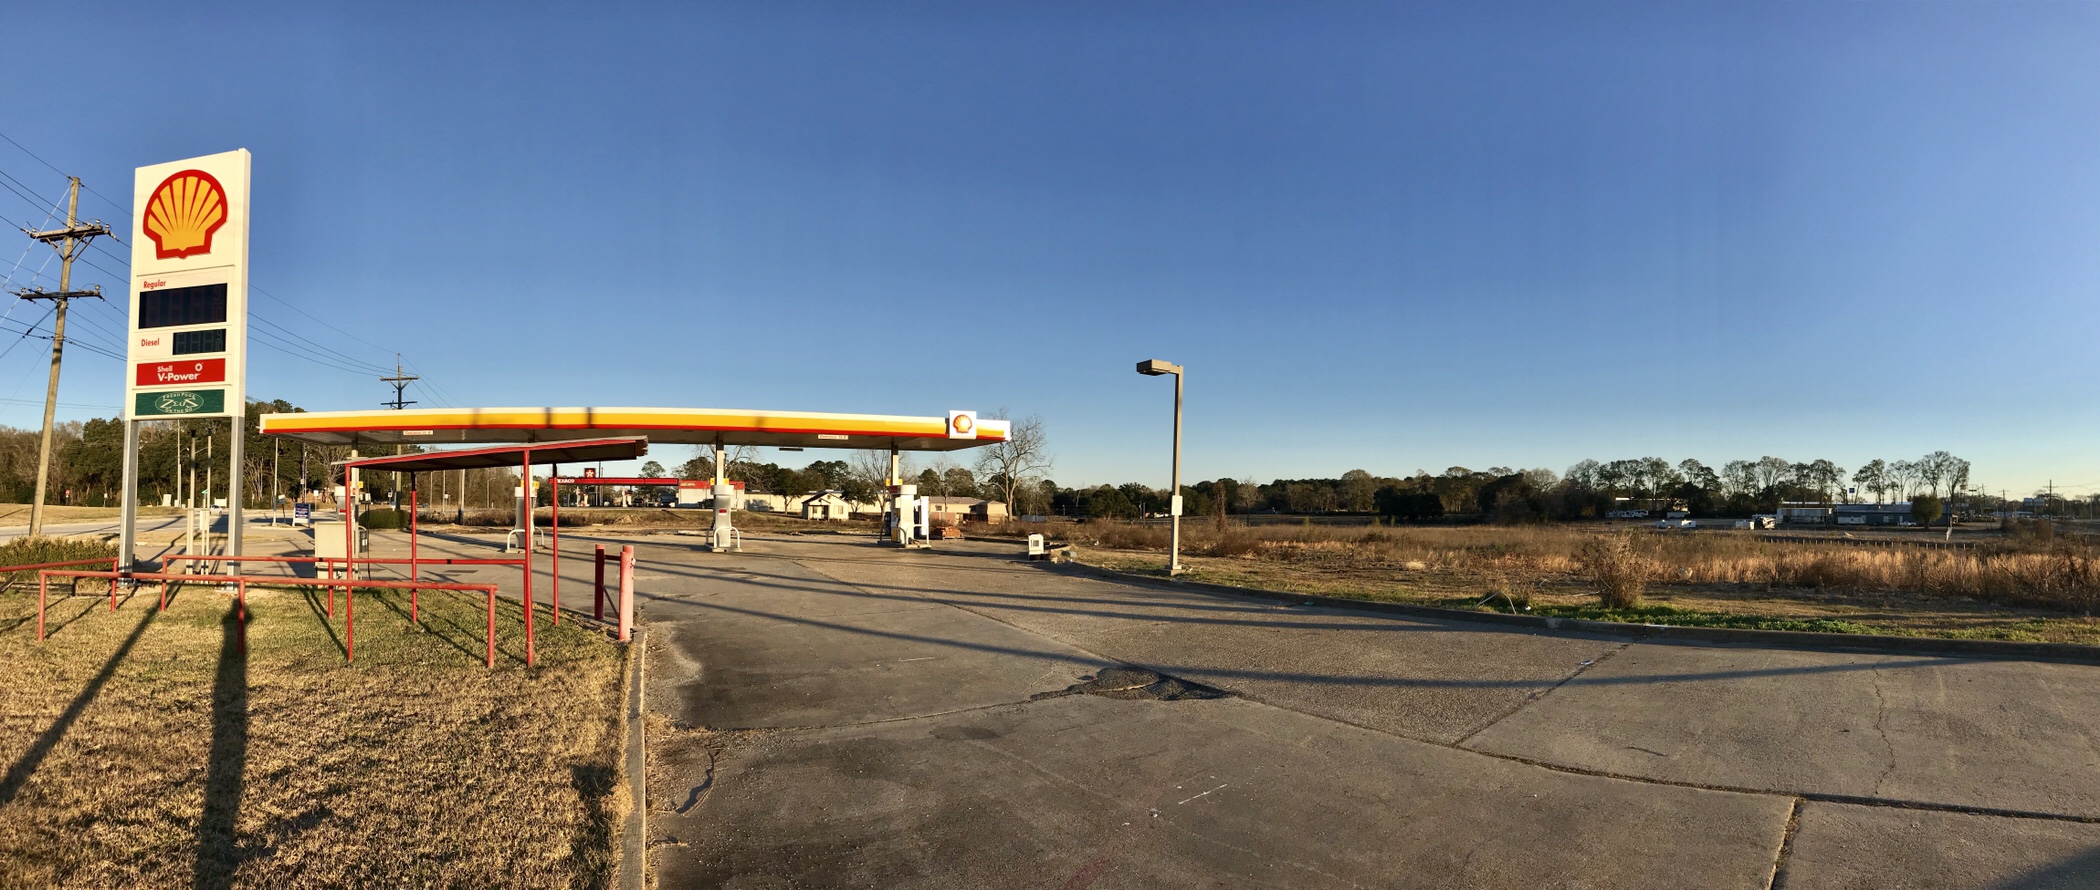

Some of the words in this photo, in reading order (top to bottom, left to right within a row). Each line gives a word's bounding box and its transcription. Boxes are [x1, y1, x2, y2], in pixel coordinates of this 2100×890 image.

[143, 279, 166, 289] Regular
[141, 338, 160, 347] Diesel
[157, 365, 173, 373] Shell
[157, 372, 199, 382] V-Power
